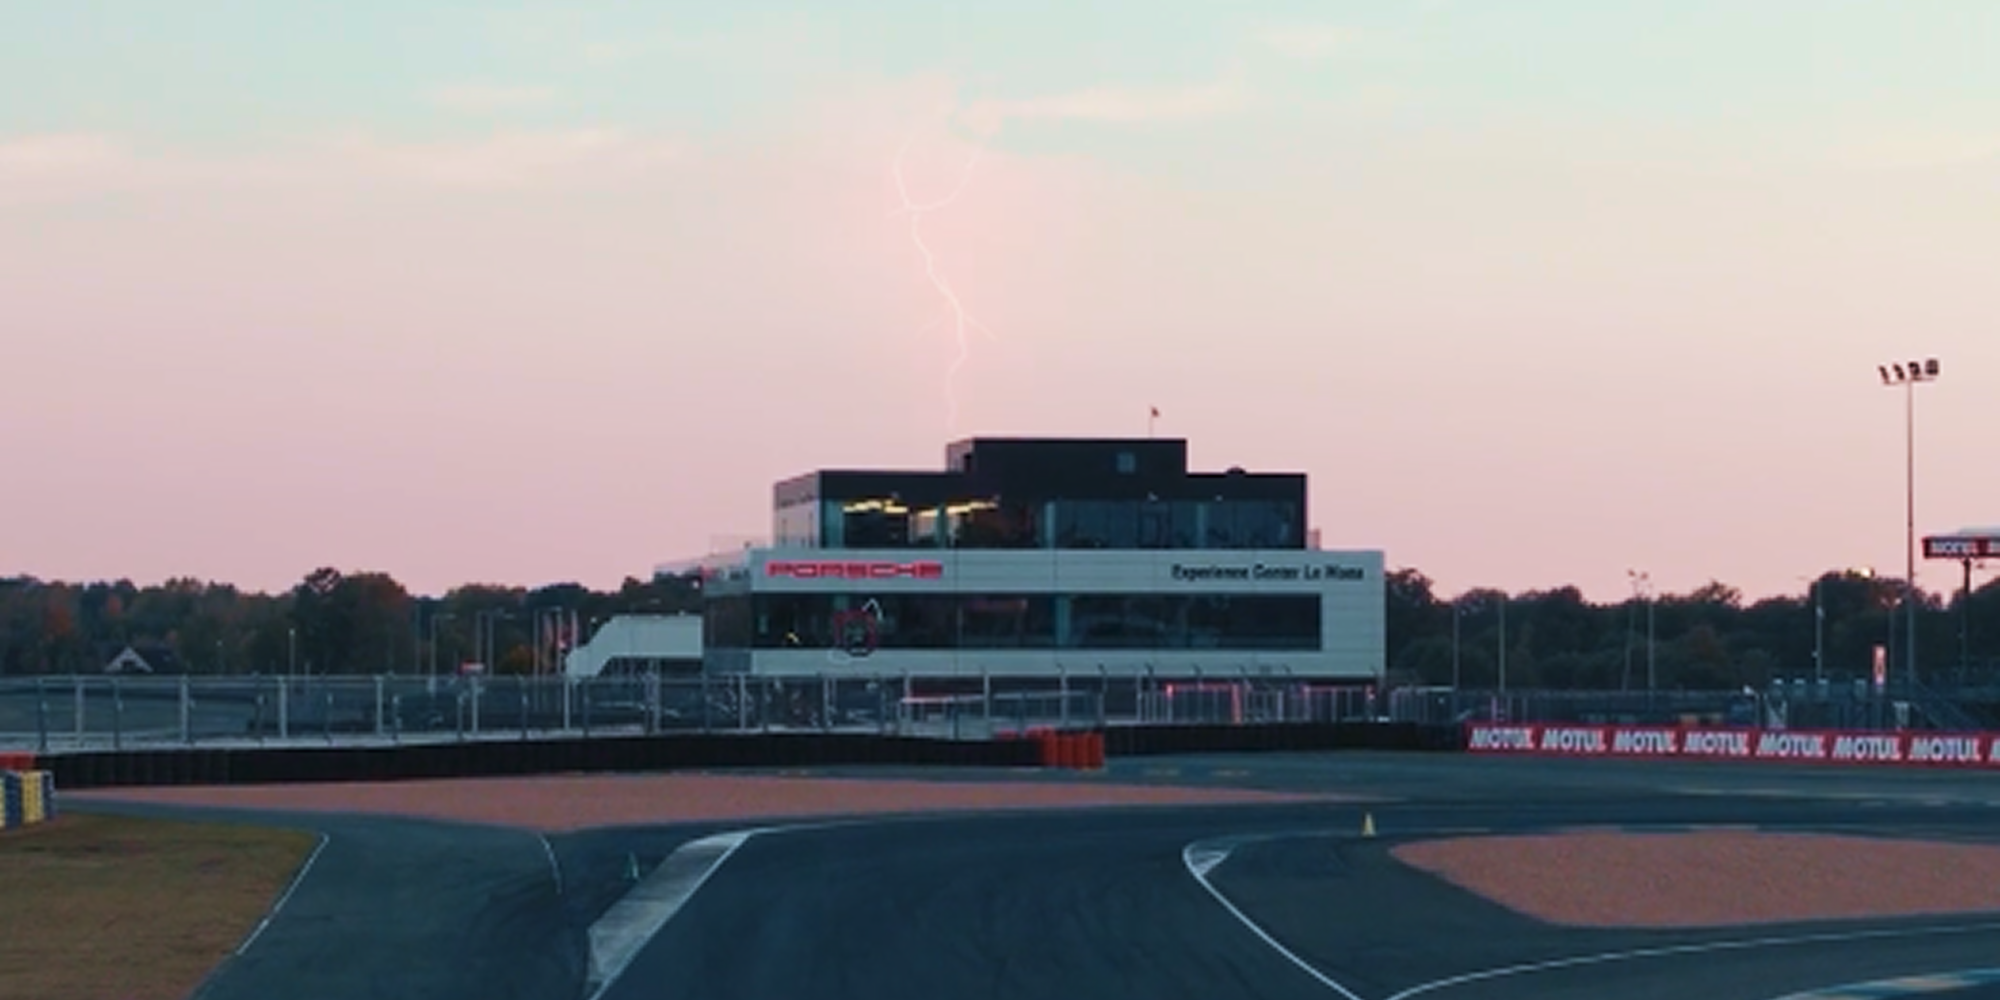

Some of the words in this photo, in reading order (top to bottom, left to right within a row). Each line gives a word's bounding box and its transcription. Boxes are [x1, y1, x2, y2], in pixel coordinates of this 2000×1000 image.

[766, 560, 943, 580] PORSCHE
[1171, 564, 1249, 581] Experience
[1303, 565, 1321, 580] Le
[1470, 728, 1535, 749] MOTUL
[1541, 728, 1607, 751] MOTUL
[1613, 730, 1678, 752] MOTUL
[1683, 731, 1749, 754] MOTUL
[1756, 733, 1825, 757] MOTUL
[1832, 735, 1903, 760] MOTUL
[1908, 737, 1981, 761] MOTUL
